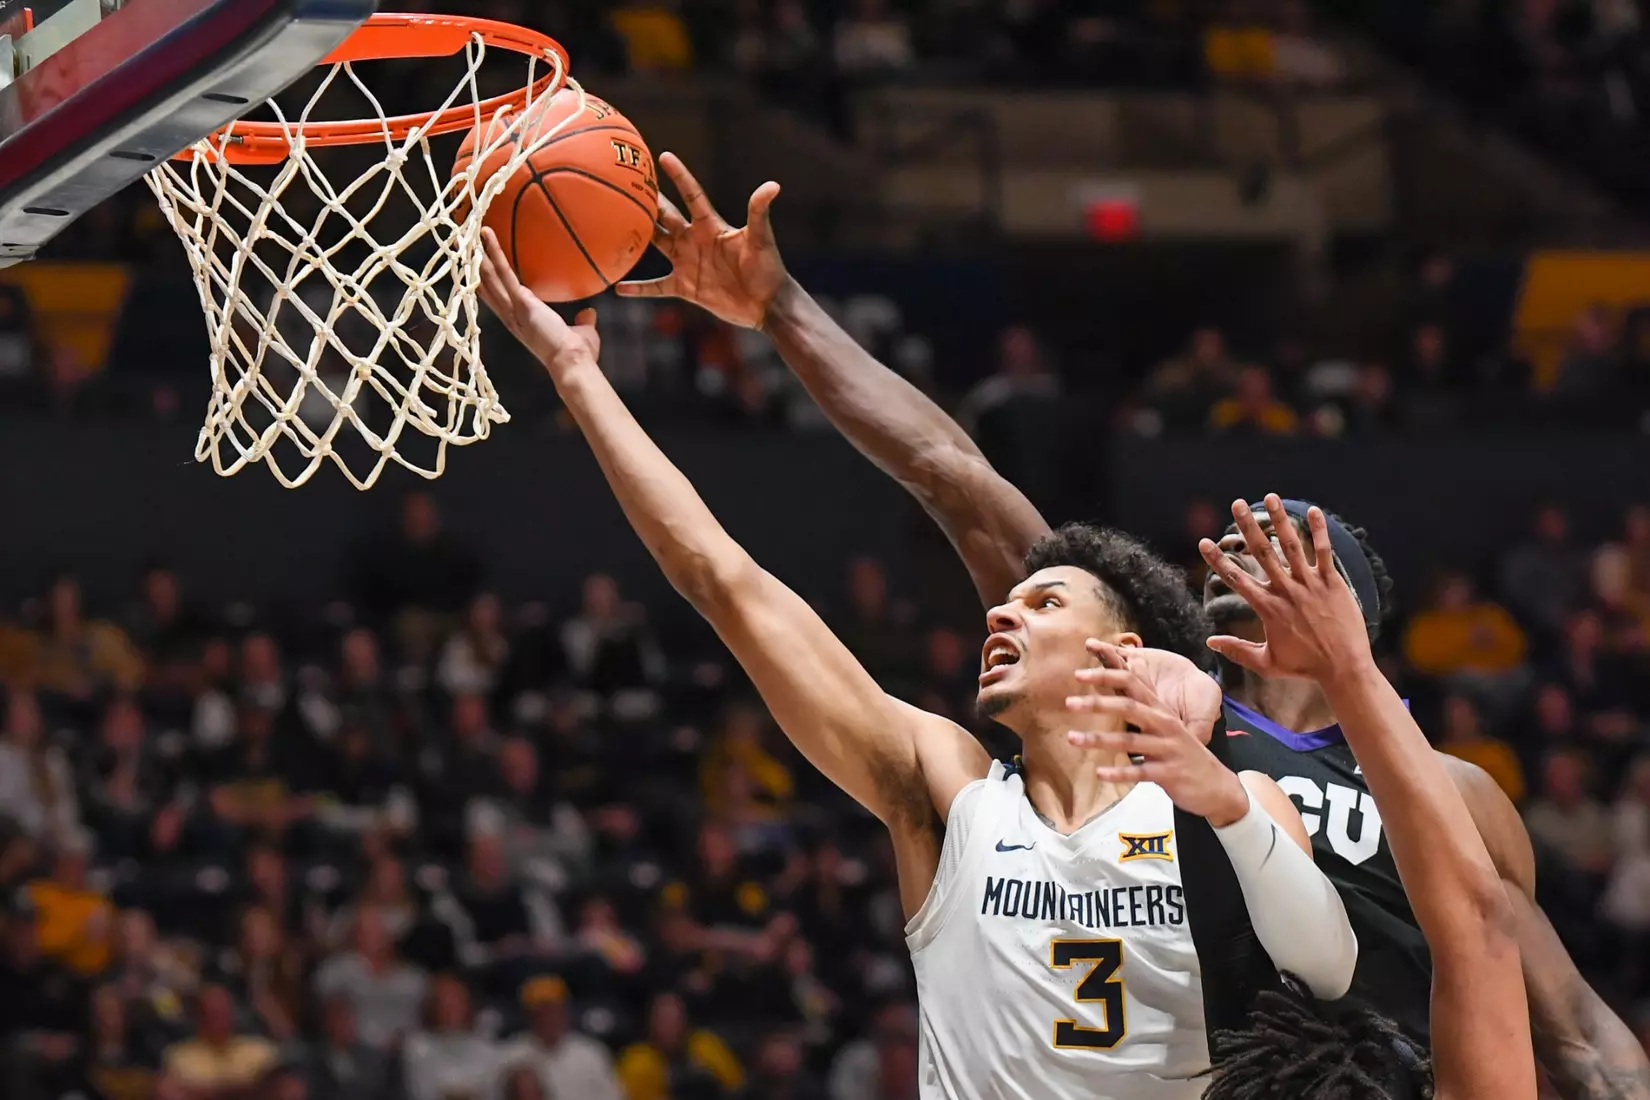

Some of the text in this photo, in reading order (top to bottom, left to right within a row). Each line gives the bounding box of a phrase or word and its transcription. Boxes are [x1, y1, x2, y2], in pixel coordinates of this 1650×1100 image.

[1275, 775, 1383, 866] CU
[981, 876, 1184, 928] MOUNTAINEERS
[1050, 938, 1127, 1050] 3
